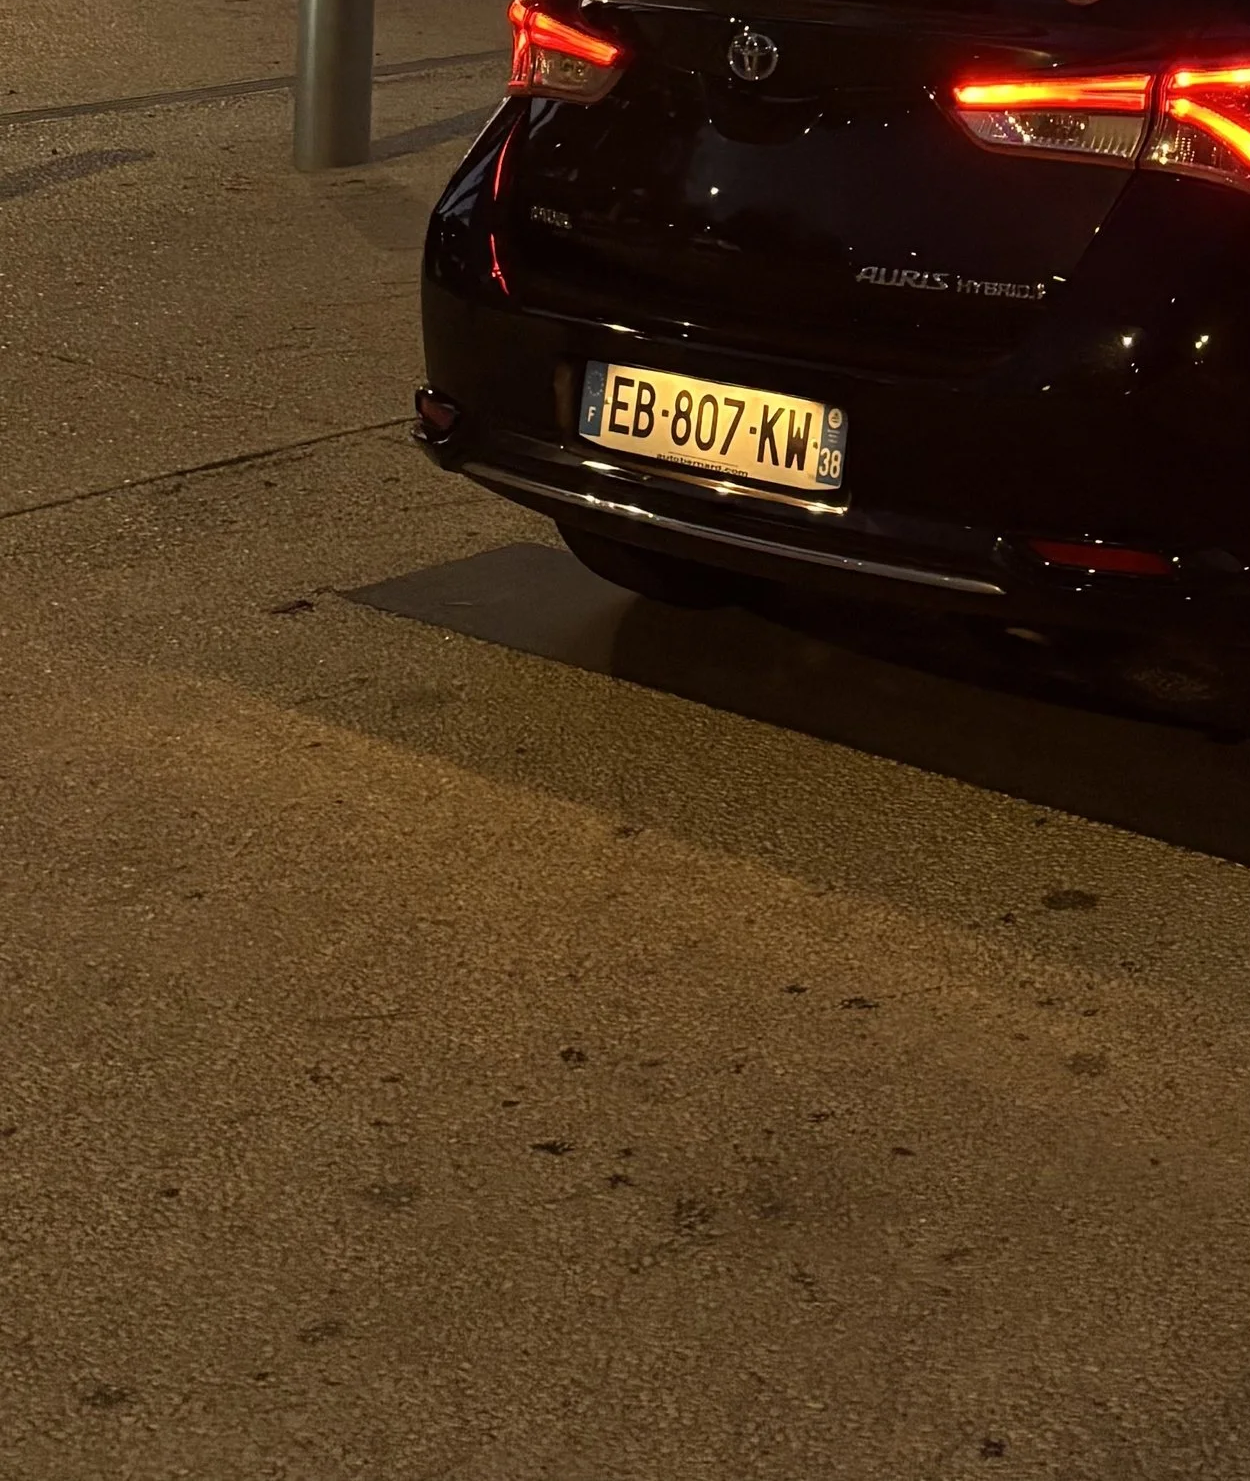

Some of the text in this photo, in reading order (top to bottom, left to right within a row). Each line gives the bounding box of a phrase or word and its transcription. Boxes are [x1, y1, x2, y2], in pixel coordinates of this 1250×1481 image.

[855, 266, 1031, 299] AURIS HYBRID
[587, 406, 597, 423] F
[608, 375, 813, 471] EB-807-KW
[656, 453, 749, 478] autobernard.com
[818, 447, 842, 479] 38
